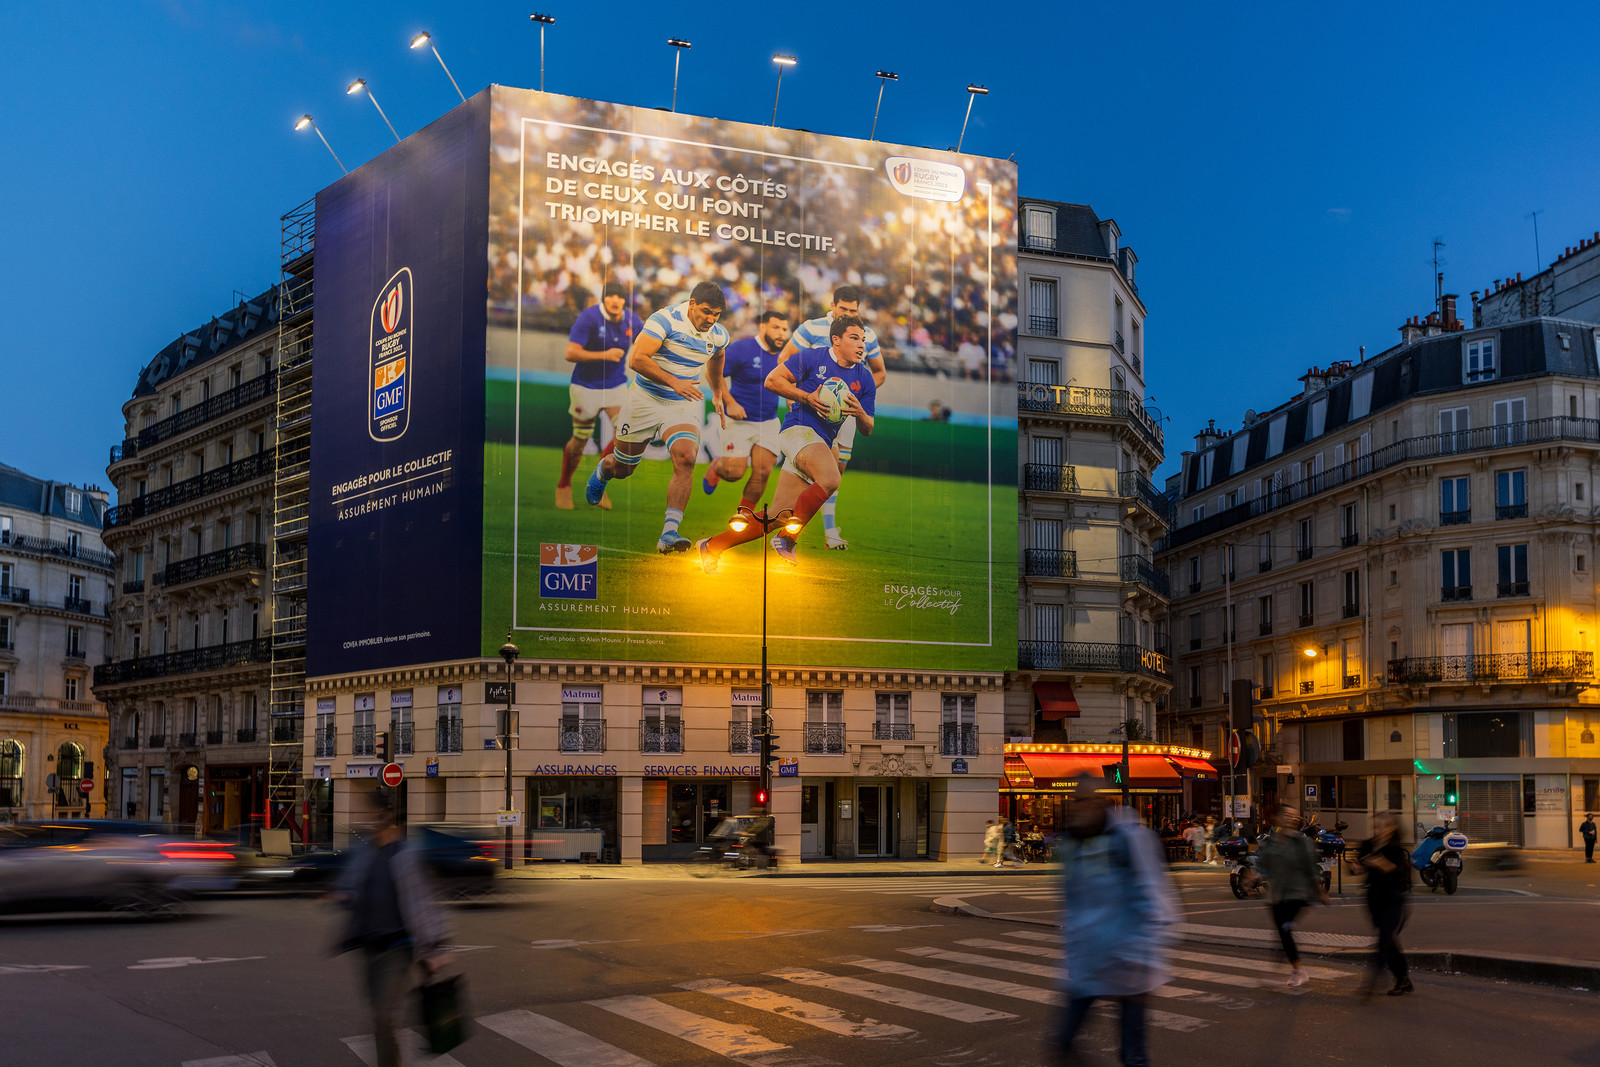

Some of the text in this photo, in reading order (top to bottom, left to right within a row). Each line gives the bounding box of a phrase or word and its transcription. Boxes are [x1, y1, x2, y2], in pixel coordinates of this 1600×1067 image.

[547, 152, 787, 199] ENGAGÉS AUX CÔTÉS
[914, 172, 939, 181] RUGBY
[546, 177, 763, 219] DE CEUX QUI FONT
[545, 202, 836, 253] TRIOMPHER LE COLLECTIF.
[381, 337, 400, 352] RUGBY
[377, 385, 403, 410] GMF
[621, 423, 630, 436] 6
[332, 449, 452, 496] ENGAGÉS POUR LE COLLECTIF
[338, 482, 443, 521] ASSURÉMENT HUMAIN
[545, 572, 593, 591] GMF
[884, 584, 961, 597] ENGAGÉS POUR
[539, 603, 671, 615] ASSURÉMENT HUMAIN
[895, 592, 963, 615] Collectif
[558, 635, 576, 643] photo
[1141, 648, 1166, 674] HOTEL
[391, 695, 412, 703] Matmut
[563, 690, 600, 698] Matmut
[733, 693, 762, 702] Matmu
[317, 702, 335, 710] Matmut
[64, 723, 80, 731] LCL
[427, 766, 437, 774] GMF
[534, 764, 618, 776] ASSURANCES
[644, 765, 774, 776] SERVICES FINANCIES
[780, 766, 796, 774] GMF
[1308, 786, 1315, 795] P
